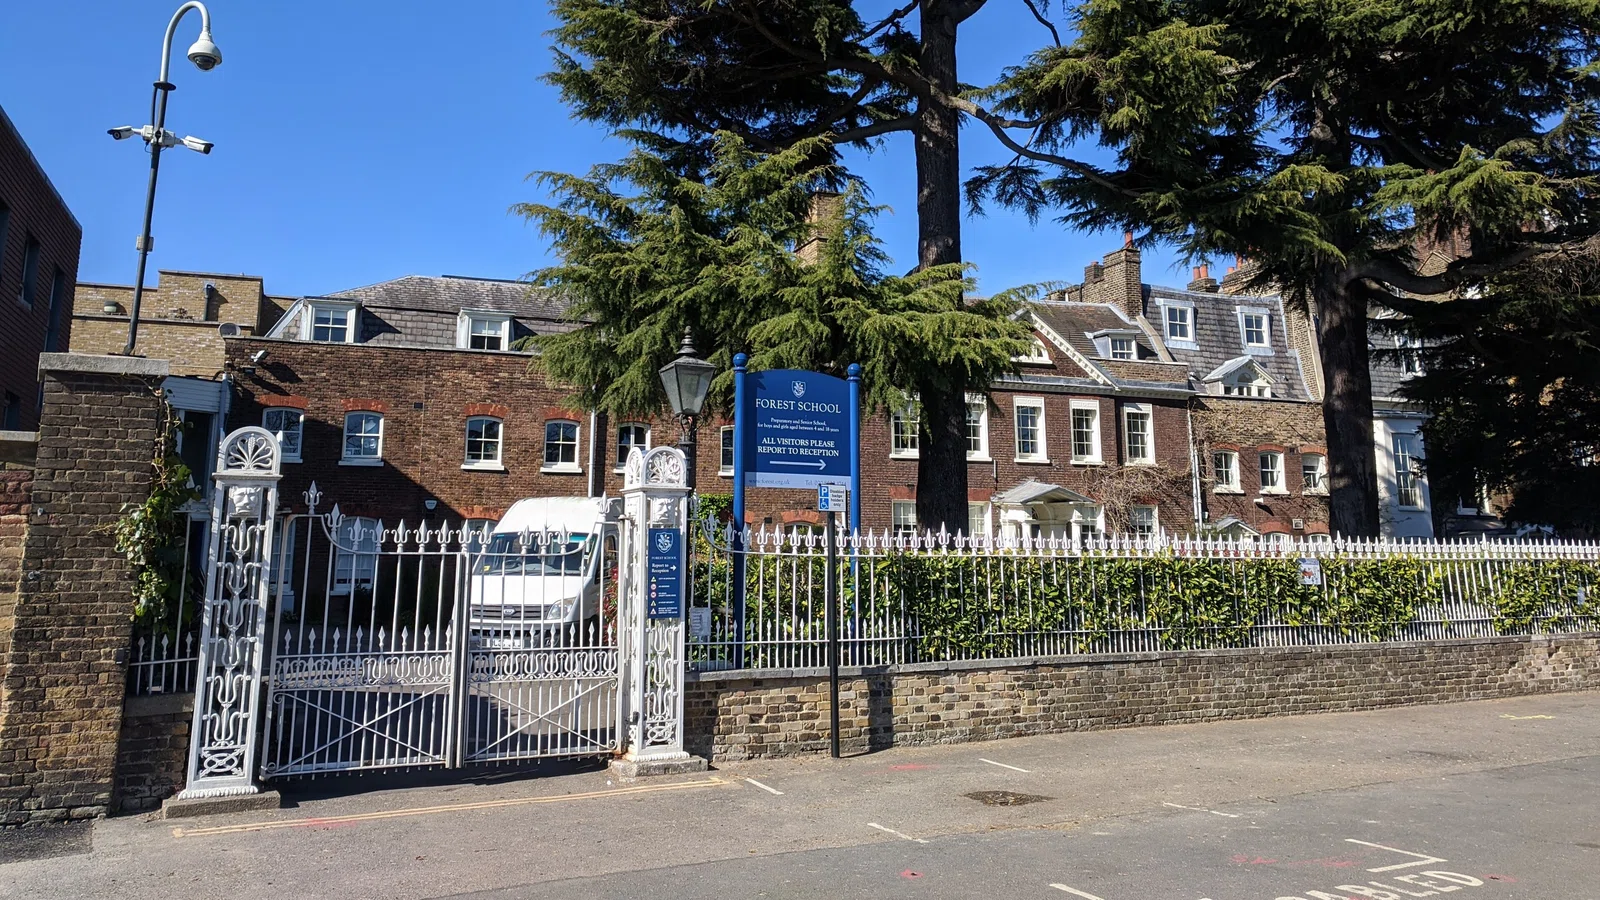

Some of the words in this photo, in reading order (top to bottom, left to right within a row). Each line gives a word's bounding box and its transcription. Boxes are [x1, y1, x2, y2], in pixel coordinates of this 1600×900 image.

[756, 398, 796, 410] FOREST
[798, 401, 842, 414] SCHOOL
[777, 438, 809, 446] VISITORS
[810, 440, 835, 448] PLEASE
[757, 446, 787, 454] REPORT
[800, 448, 839, 457] RECEPTION
[822, 487, 828, 496] P
